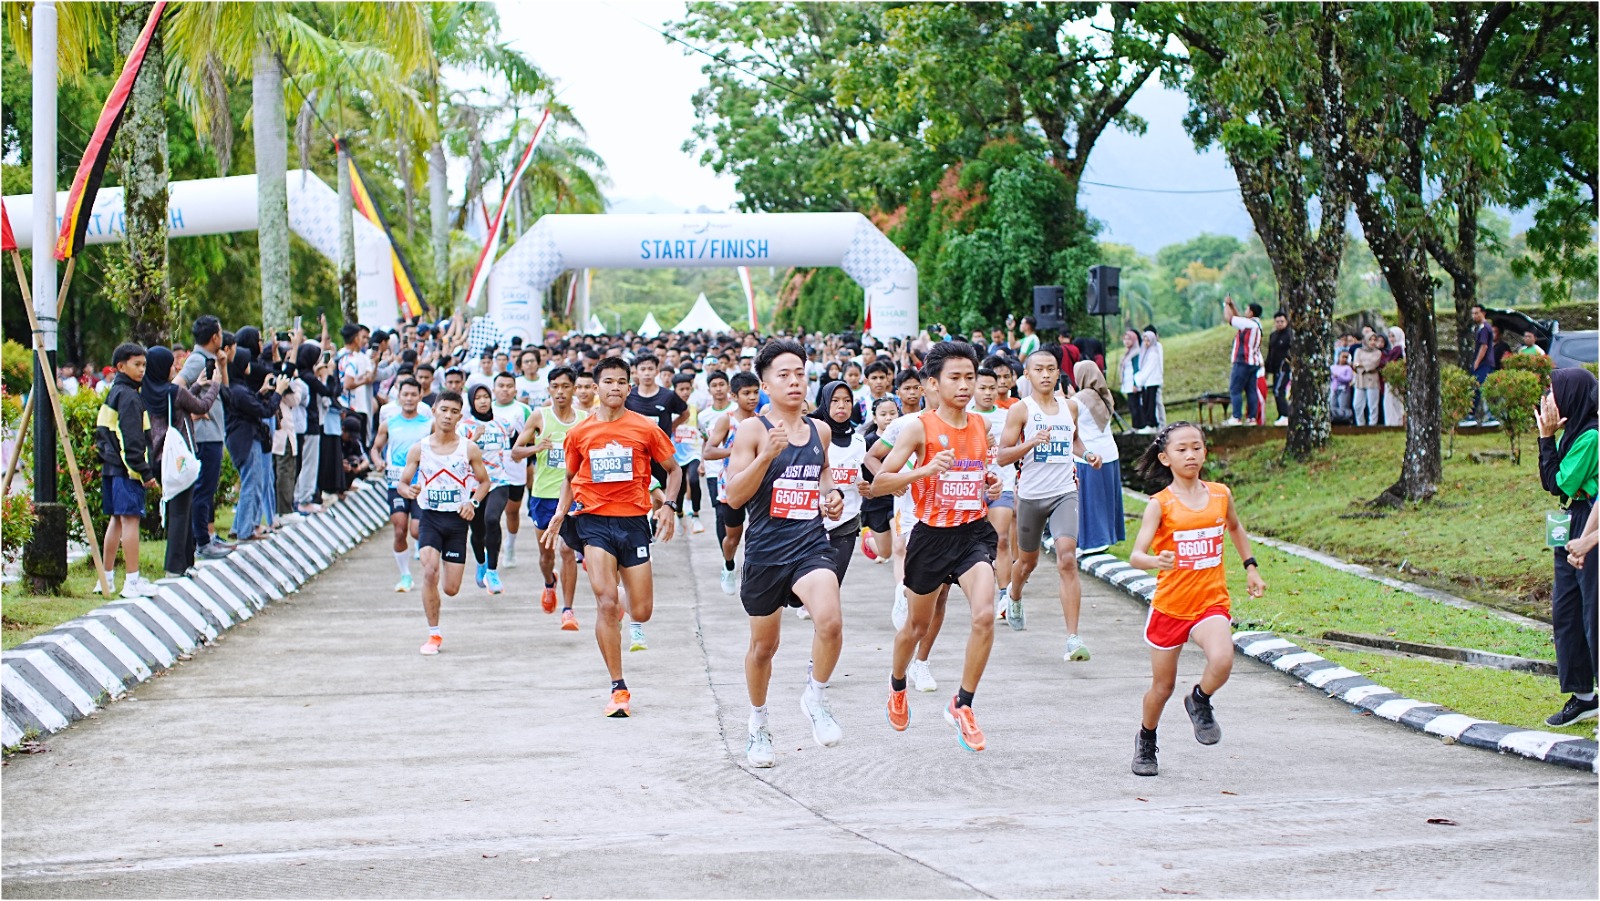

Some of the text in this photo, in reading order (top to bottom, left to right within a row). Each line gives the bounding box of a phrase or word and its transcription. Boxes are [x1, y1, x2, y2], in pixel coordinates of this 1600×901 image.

[641, 239, 768, 259] START/FINISH
[549, 449, 564, 459] 631
[592, 457, 622, 472] 63083
[831, 469, 848, 481] 005
[429, 490, 452, 502] 63101
[942, 482, 976, 497] 65052
[775, 489, 811, 507] 65067
[1178, 539, 1214, 556] 66001
